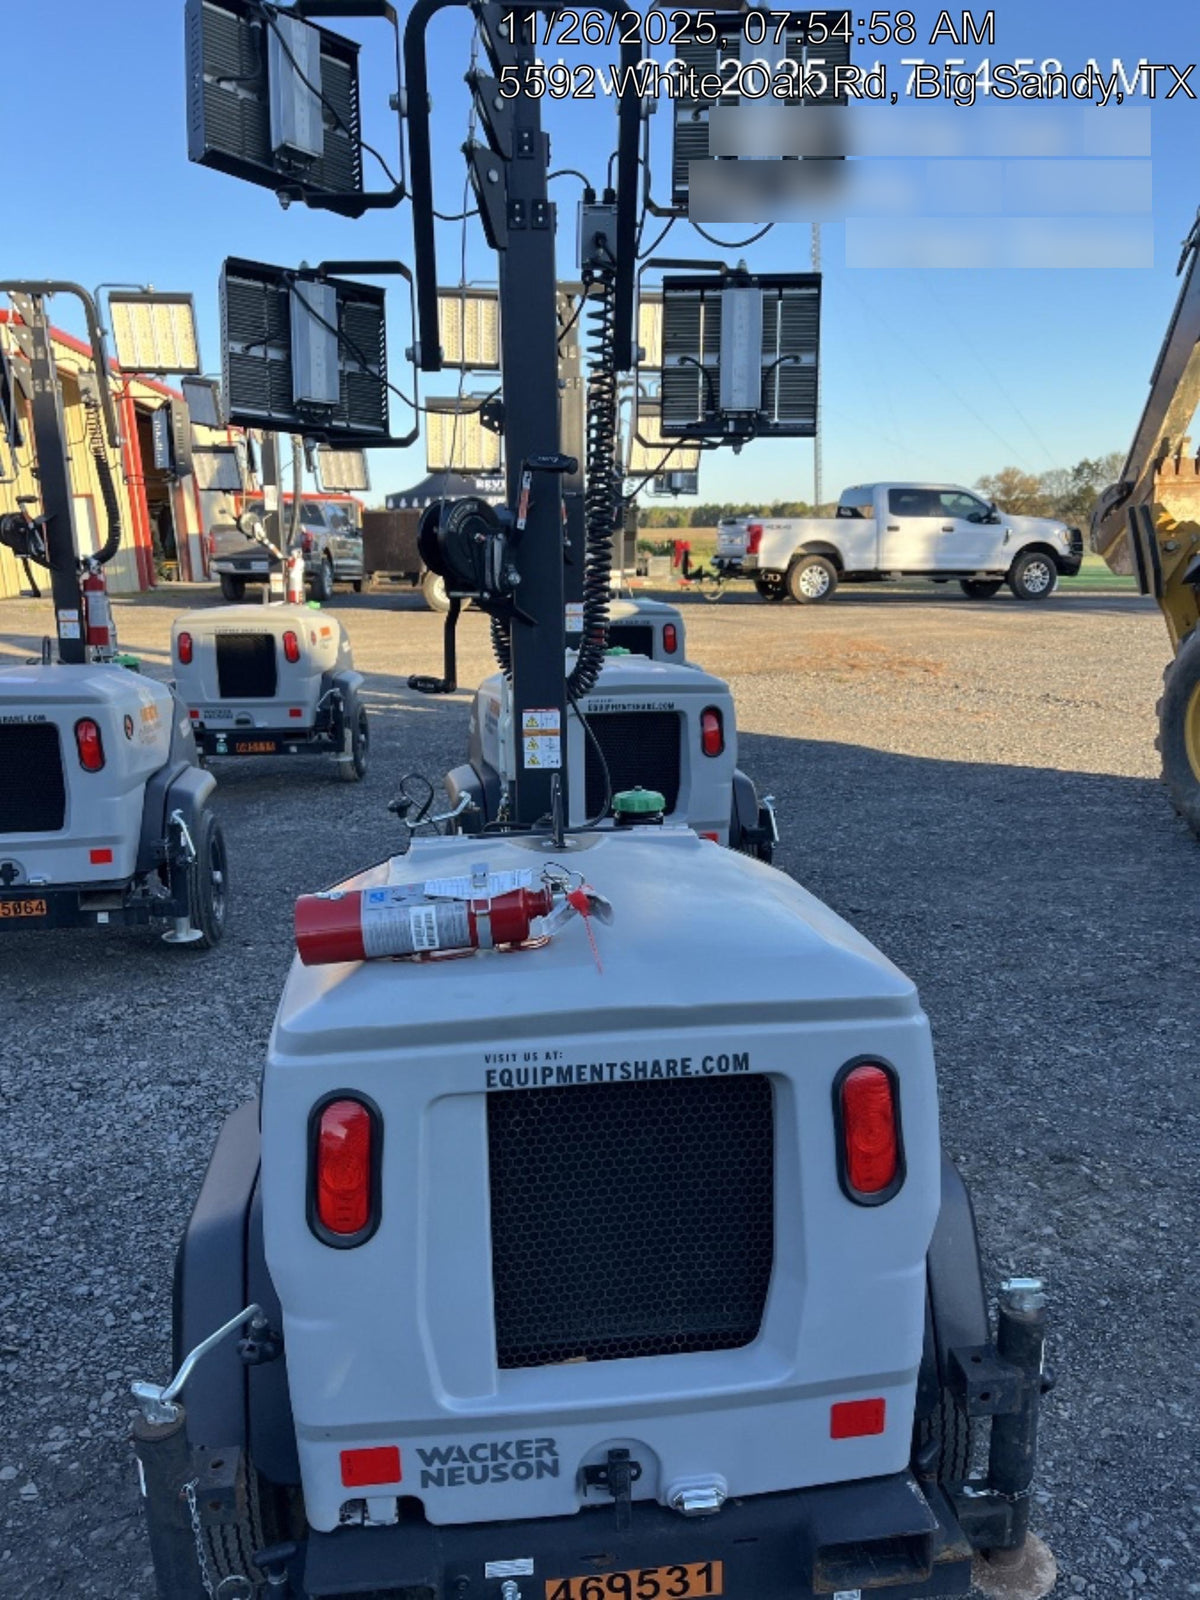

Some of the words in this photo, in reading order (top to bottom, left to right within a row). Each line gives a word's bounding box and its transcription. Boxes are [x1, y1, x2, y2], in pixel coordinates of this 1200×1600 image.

[484, 1053, 517, 1064] VISIT
[523, 1051, 538, 1062] US
[545, 1050, 563, 1061] AT:
[485, 1053, 750, 1089] EQUIPMENTSHARE.COM
[415, 1437, 559, 1468] WACKER
[420, 1458, 560, 1489] NEUSON
[550, 1562, 713, 1600] 469531
